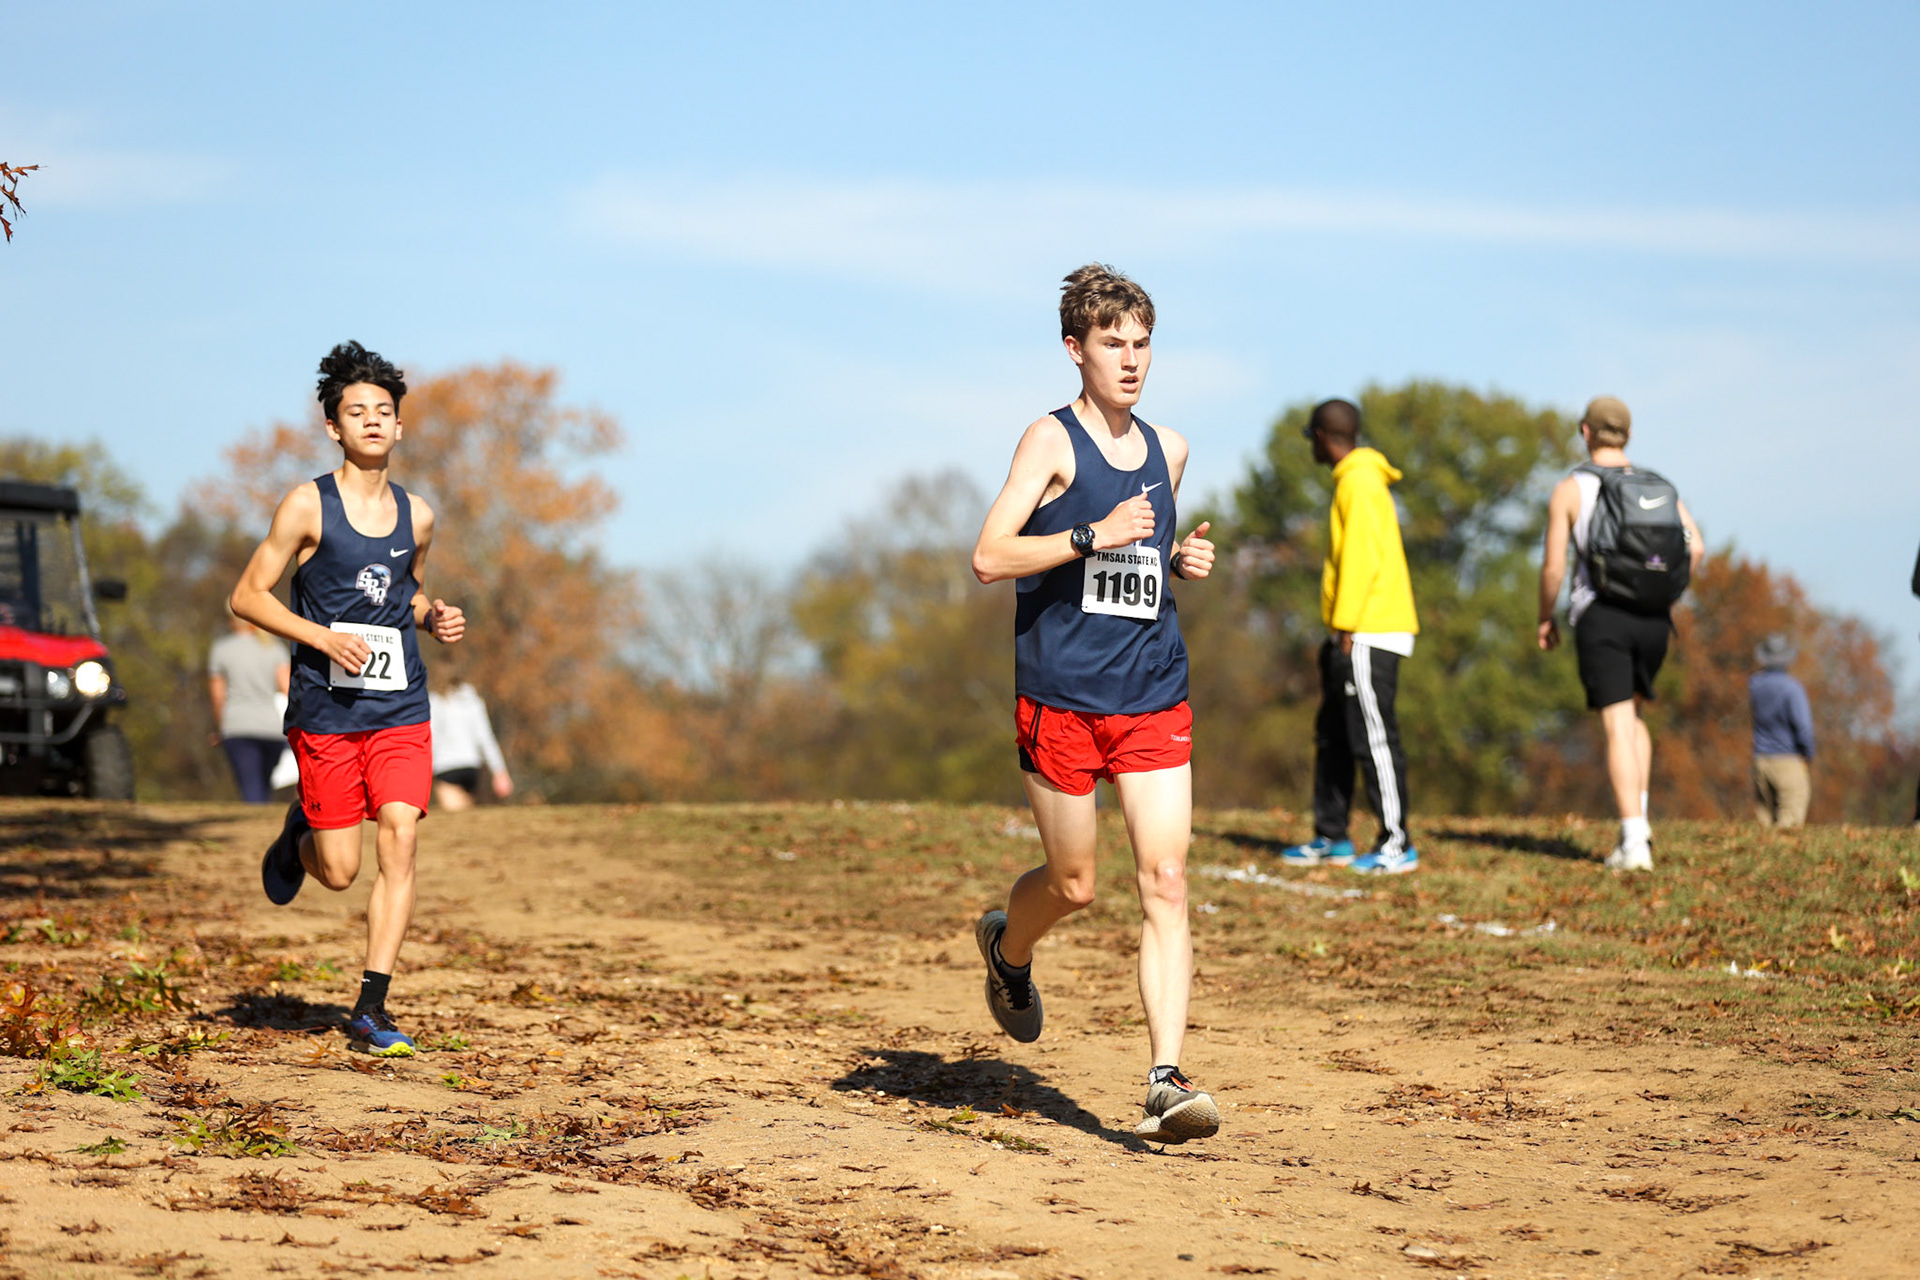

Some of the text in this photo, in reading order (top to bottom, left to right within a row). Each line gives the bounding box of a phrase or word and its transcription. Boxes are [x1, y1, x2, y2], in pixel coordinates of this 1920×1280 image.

[1096, 552, 1158, 567] TMSAA STATE XC
[358, 571, 386, 604] SBA
[1093, 570, 1157, 608] 1199
[366, 633, 384, 643] STATE
[345, 651, 392, 680] 22
